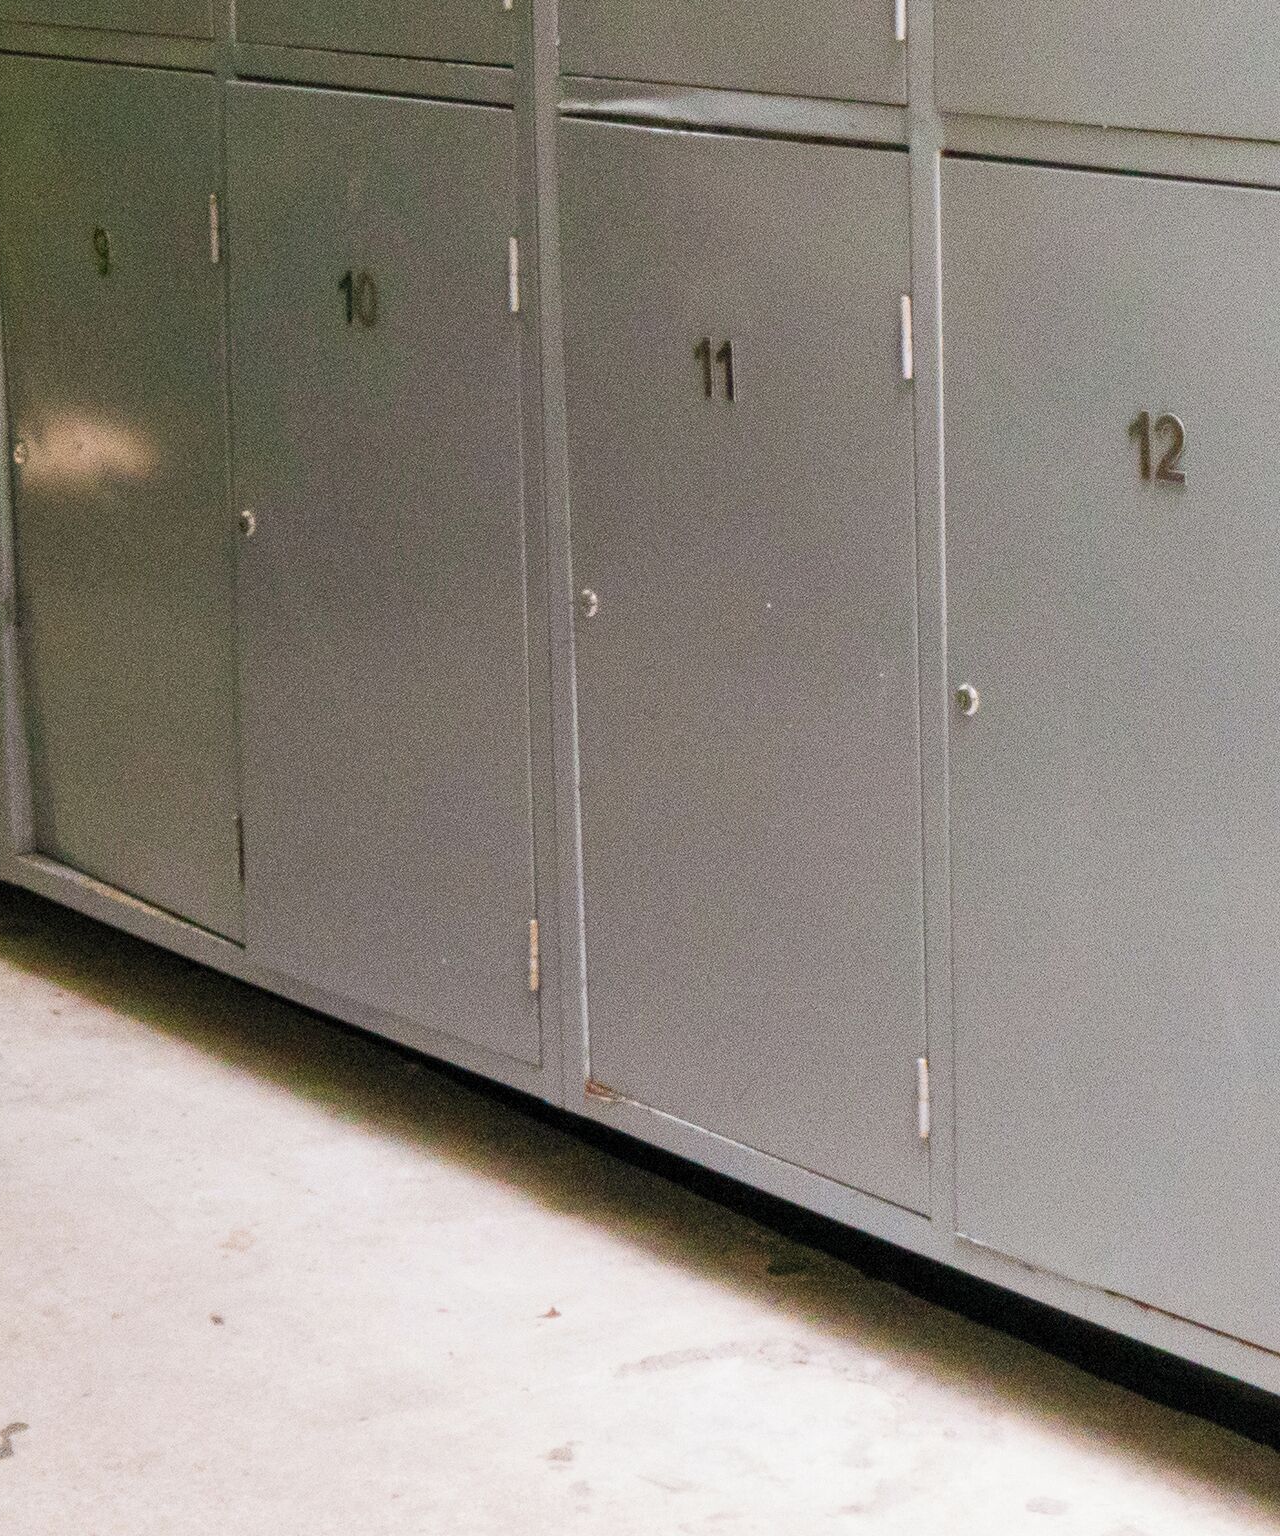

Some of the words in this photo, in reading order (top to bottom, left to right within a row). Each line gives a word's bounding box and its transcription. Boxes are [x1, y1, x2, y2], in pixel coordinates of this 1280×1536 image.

[91, 226, 112, 278] 9
[337, 268, 380, 328] 10
[693, 337, 734, 403] 11
[1127, 410, 1186, 485] 12
